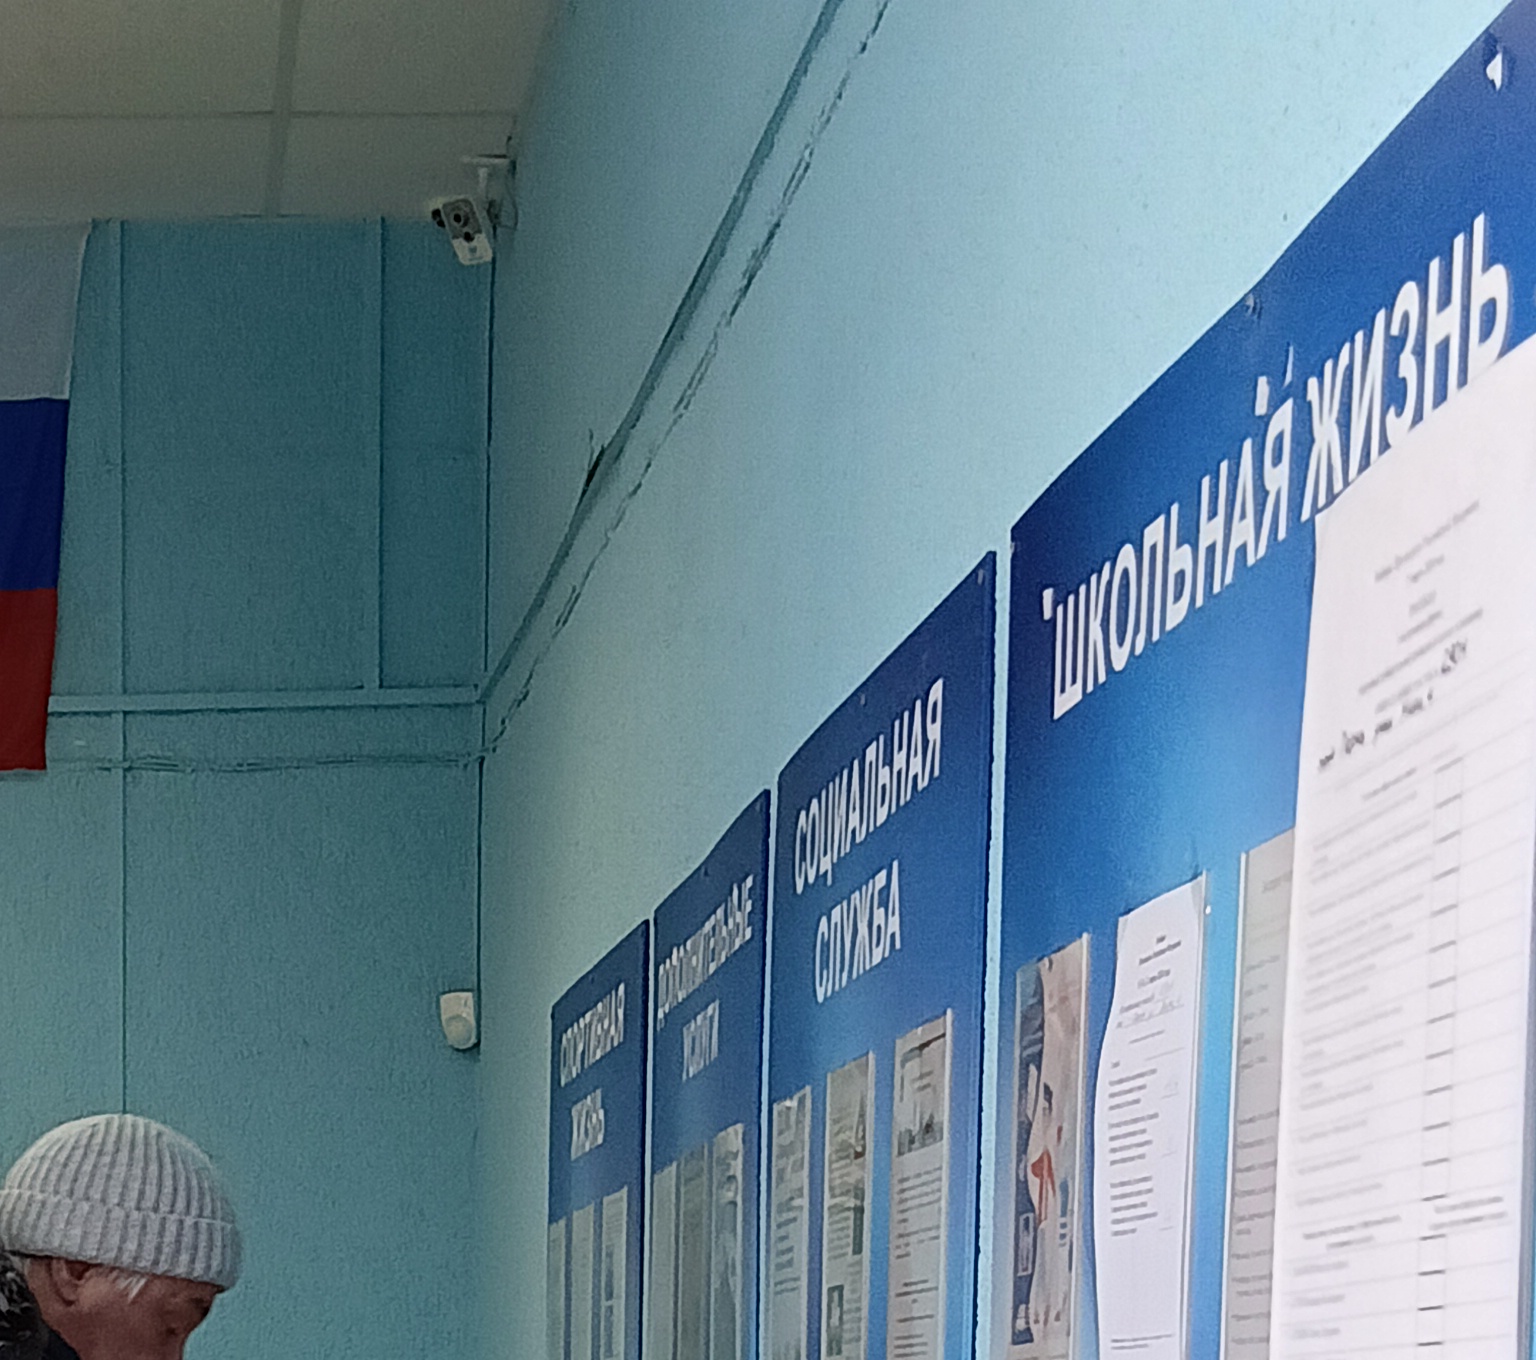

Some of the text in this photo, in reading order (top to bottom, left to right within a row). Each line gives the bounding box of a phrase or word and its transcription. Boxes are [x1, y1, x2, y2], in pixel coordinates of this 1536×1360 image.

[1054, 397, 1294, 720] ШКОЛЬНАЯ
[1300, 212, 1510, 524] ЖИЗНЬ
[795, 677, 944, 895] СОЦИАЛЬНАЯ
[815, 859, 902, 1004] СЛУЖБА
